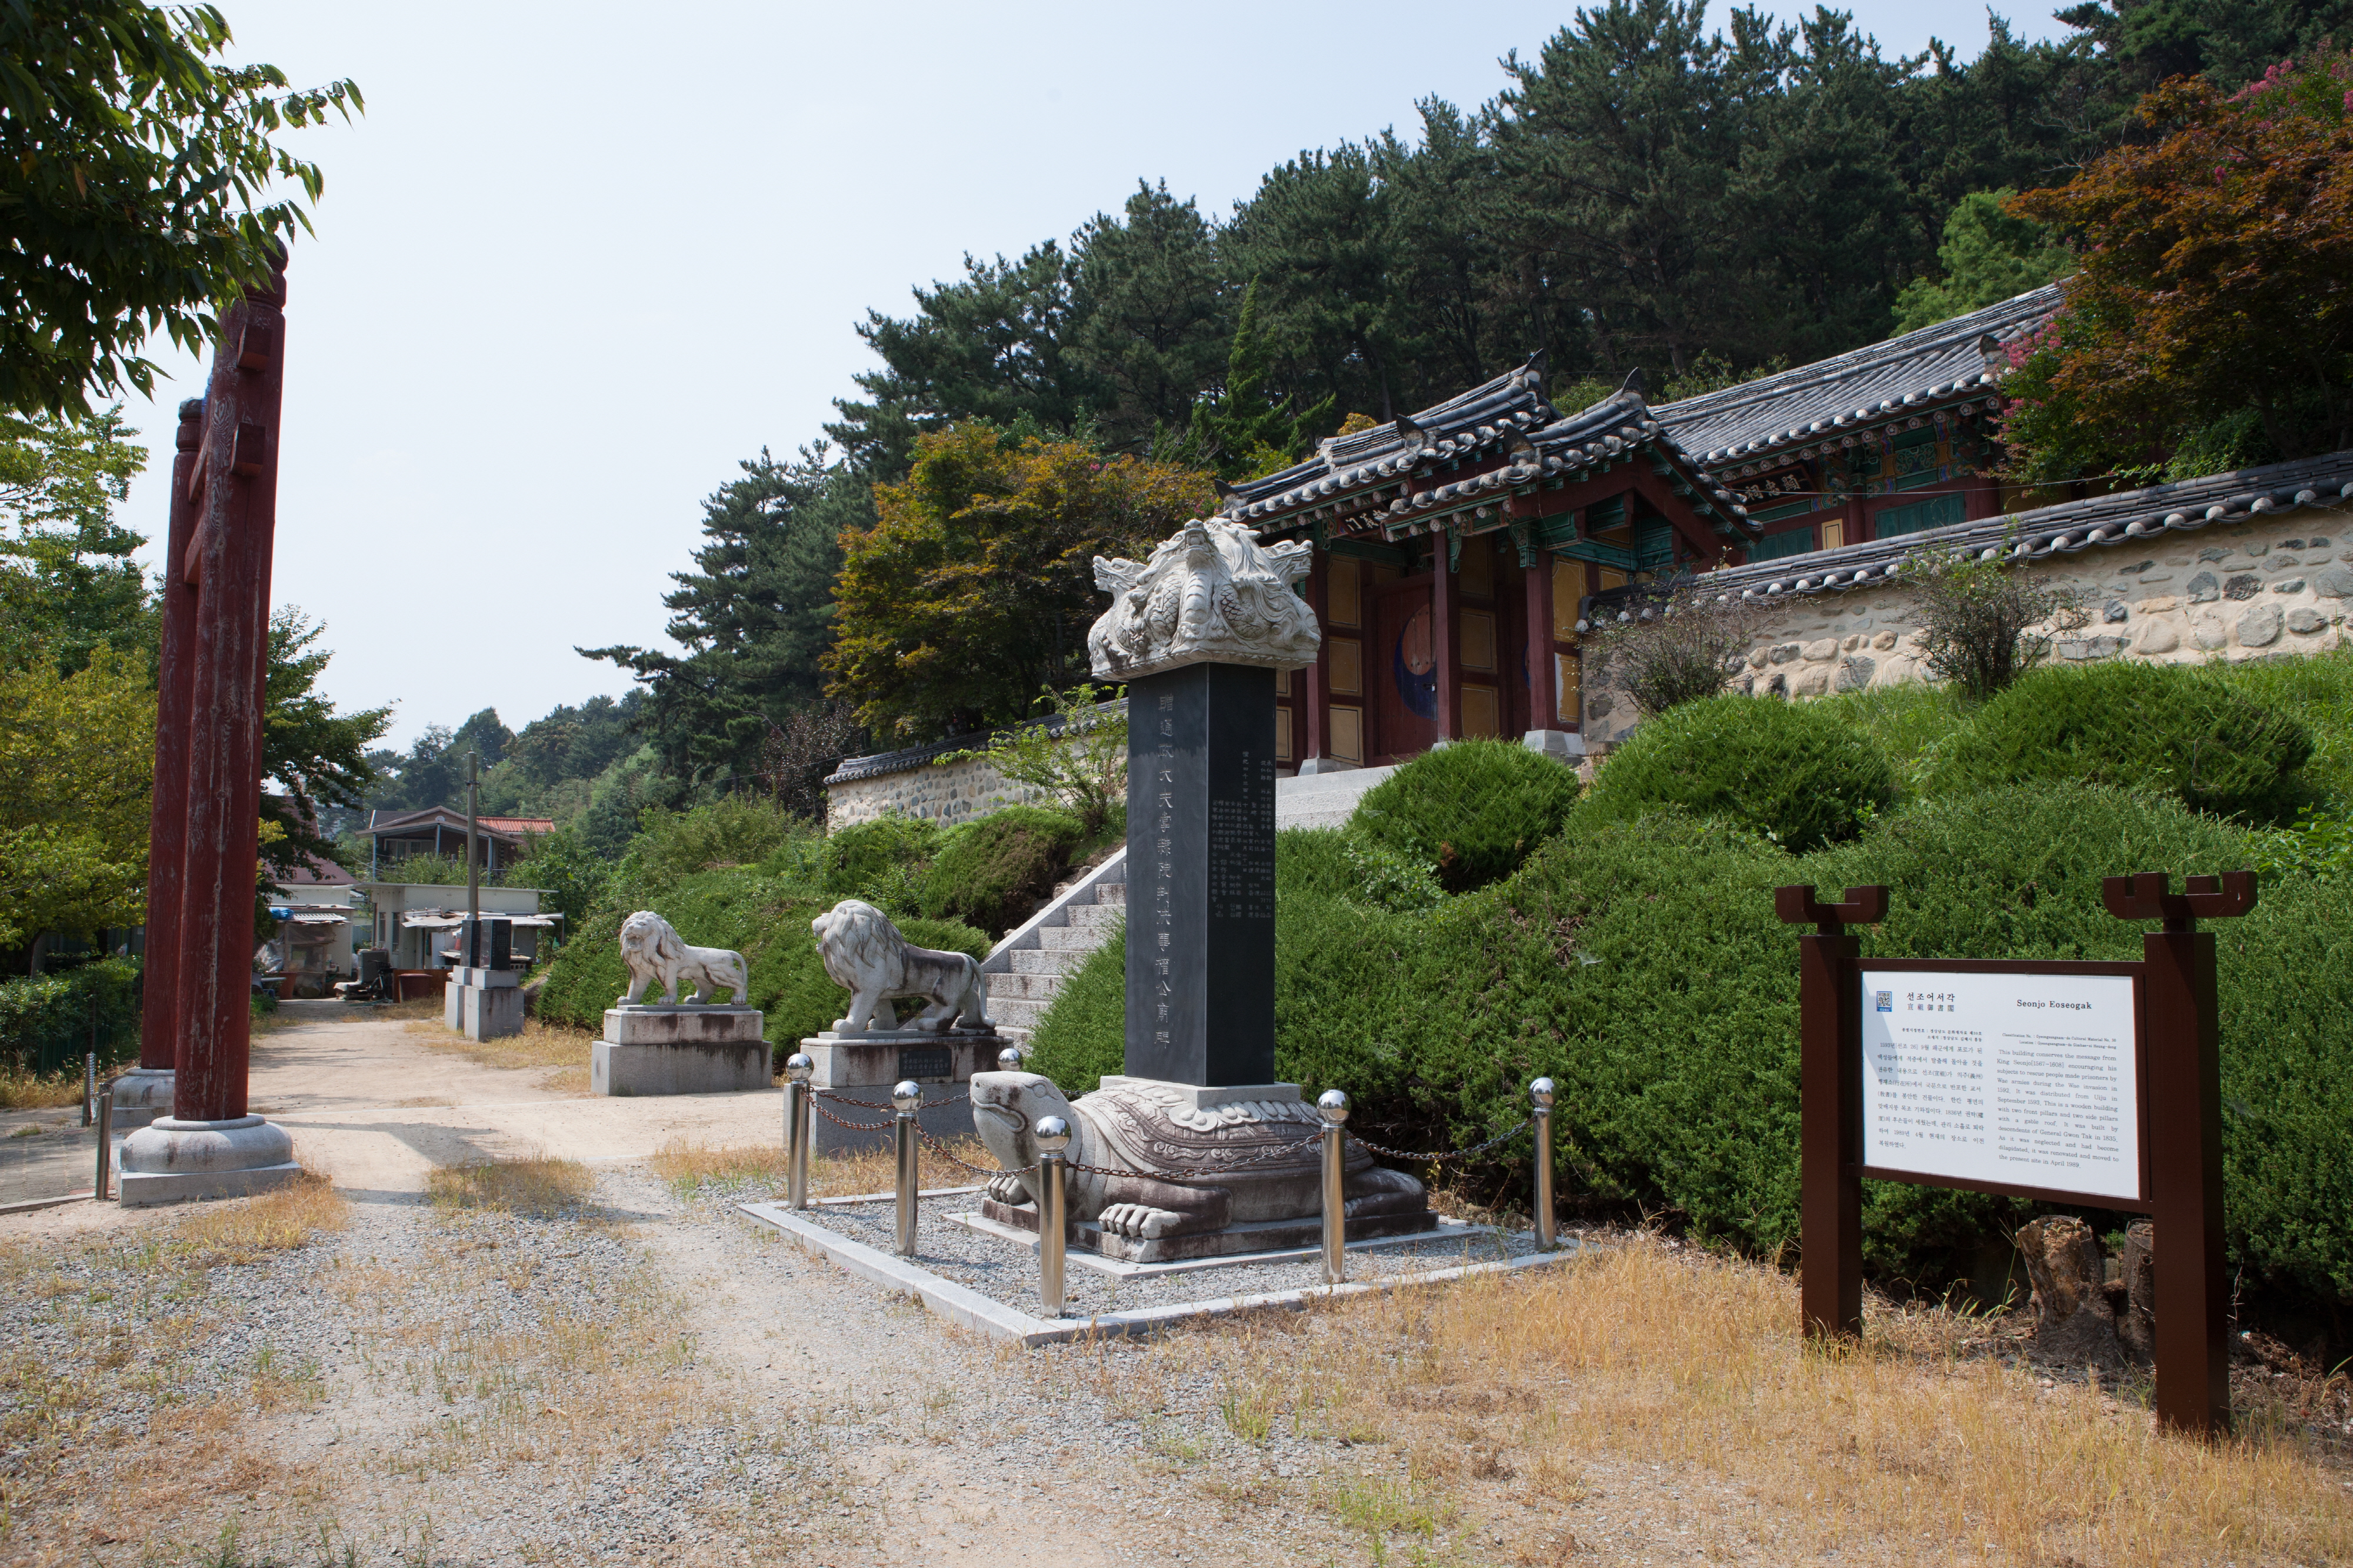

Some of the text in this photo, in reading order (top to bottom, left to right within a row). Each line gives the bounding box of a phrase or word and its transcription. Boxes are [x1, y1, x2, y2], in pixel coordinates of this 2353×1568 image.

[2017, 999, 2092, 1010] Seonjo Eoseogak
[1879, 1140, 1906, 1148] 복원하였다.
[1998, 1145, 2030, 1153] dilapidated,
